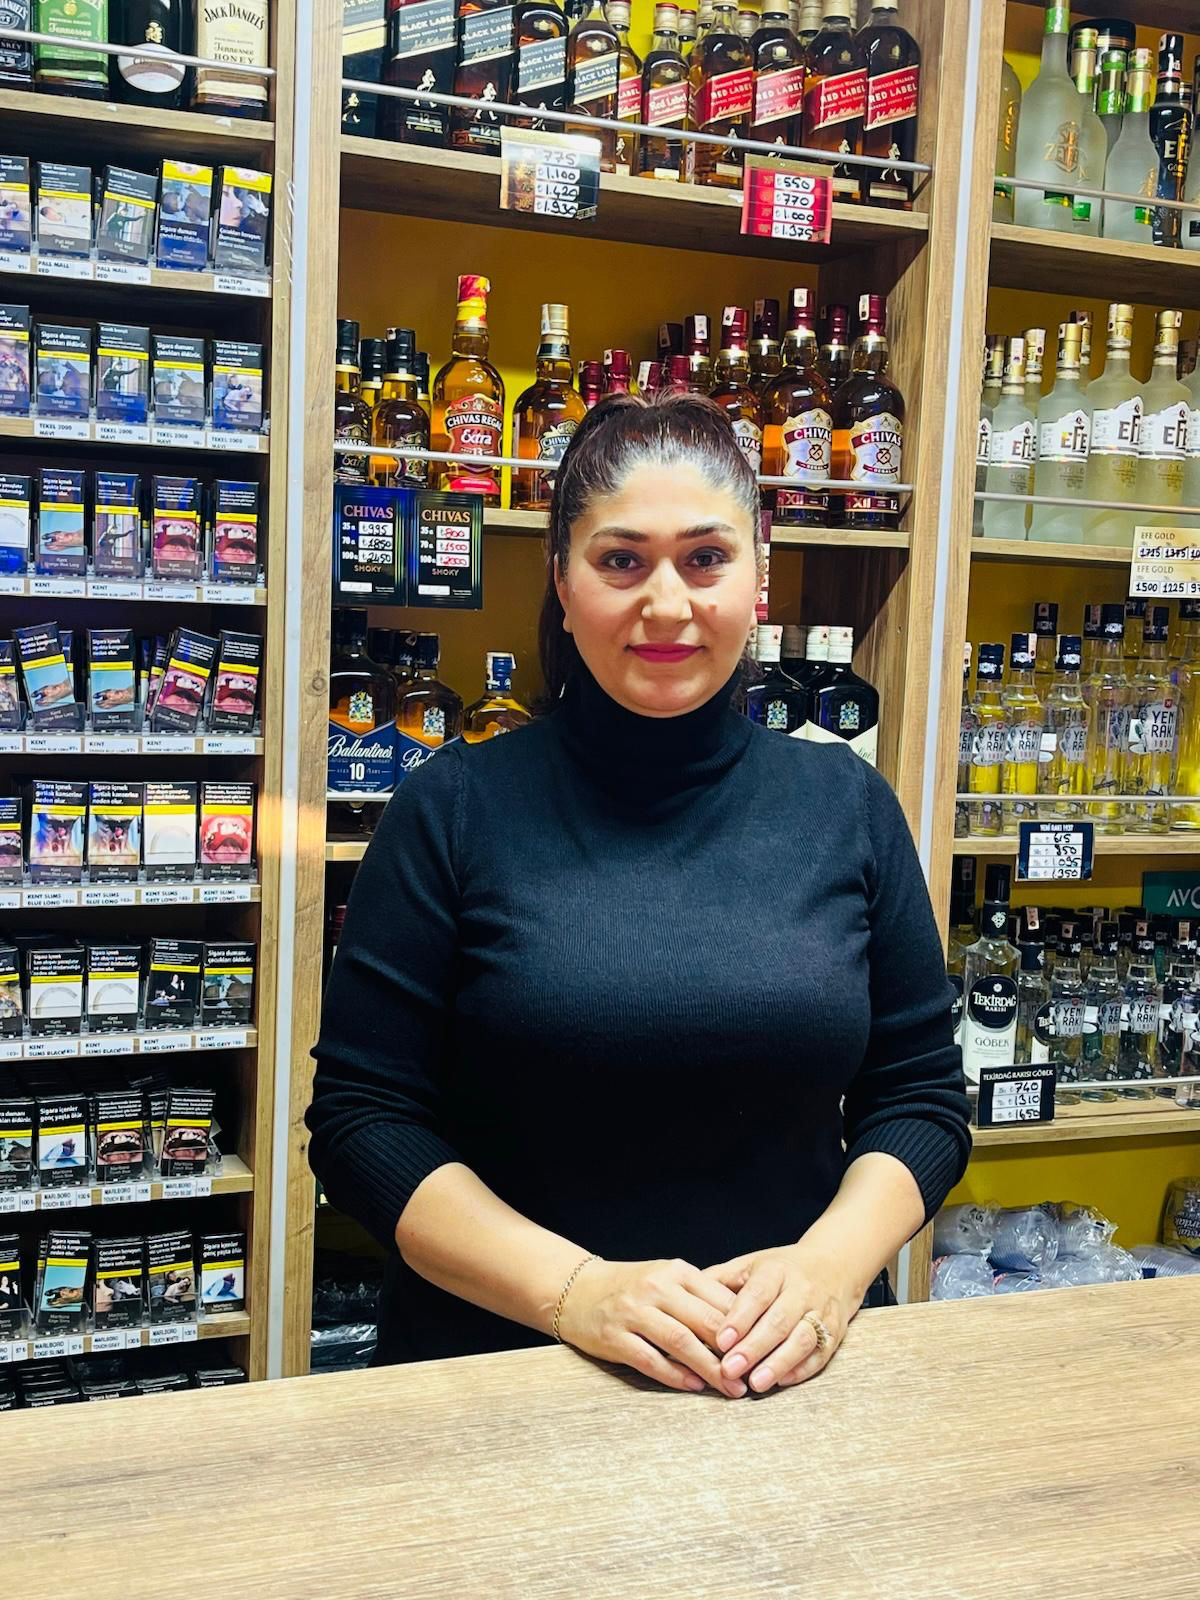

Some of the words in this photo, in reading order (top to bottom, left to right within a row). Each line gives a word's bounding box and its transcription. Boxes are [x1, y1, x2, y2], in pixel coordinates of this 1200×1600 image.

[204, 5, 227, 22] JACK
[229, 3, 265, 31] DANIEL'S
[400, 21, 428, 32] BLACK
[430, 15, 455, 25] LABEL
[711, 90, 728, 99] RED
[730, 84, 752, 95] LABEL
[776, 82, 803, 95] LABEL
[820, 93, 838, 103] RED
[840, 85, 865, 98] LABEL
[868, 92, 889, 103] RED
[890, 83, 917, 96] LABEL
[544, 150, 576, 165] 775
[784, 177, 810, 189] 550
[783, 193, 809, 206] 770
[447, 414, 481, 427] CHIVAS
[481, 414, 501, 428] REGA
[461, 430, 492, 445] Extra
[793, 428, 832, 441] CHIVAS
[861, 431, 901, 447] CHIVAS
[344, 505, 394, 519] CHIVAS
[421, 509, 470, 522] CHIVAS
[1136, 583, 1158, 592] 1500
[1163, 583, 1184, 593] 1225
[328, 734, 393, 760] Ballantine's
[349, 763, 364, 780] 10
[1014, 1082, 1038, 1093] 740
[1015, 1095, 1040, 1105] 1310
[40, 1106, 58, 1115] Sigara
